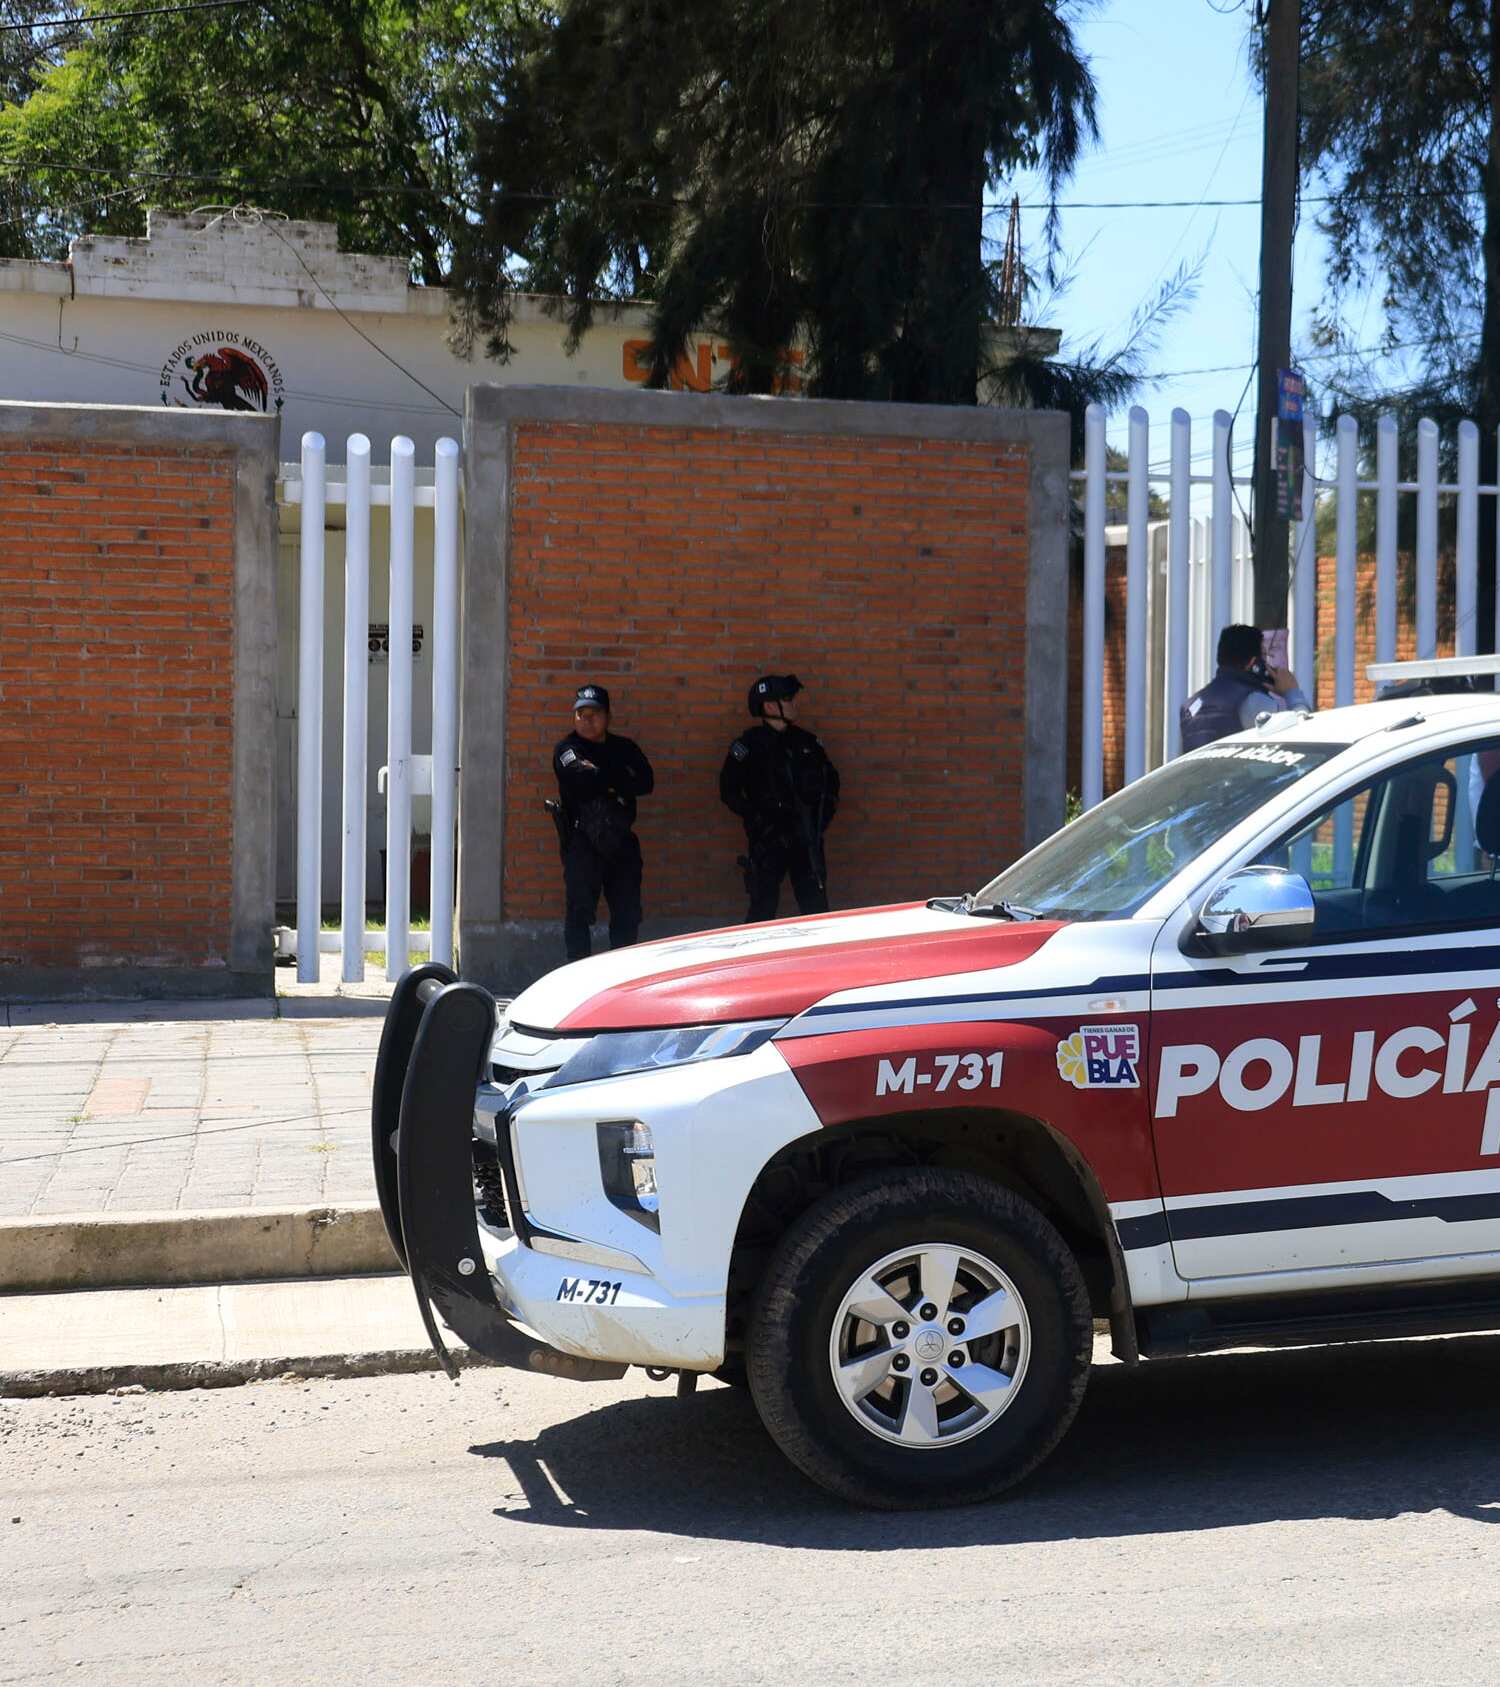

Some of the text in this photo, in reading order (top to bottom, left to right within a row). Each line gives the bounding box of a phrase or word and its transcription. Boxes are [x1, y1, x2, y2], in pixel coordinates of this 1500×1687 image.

[160, 331, 286, 394] ESTADOS UNIDOS MEXICANOS
[1083, 1034, 1137, 1060] PUE
[875, 1051, 1004, 1096] M-731
[1088, 1059, 1137, 1084] BLA
[556, 1278, 622, 1306] M-731
